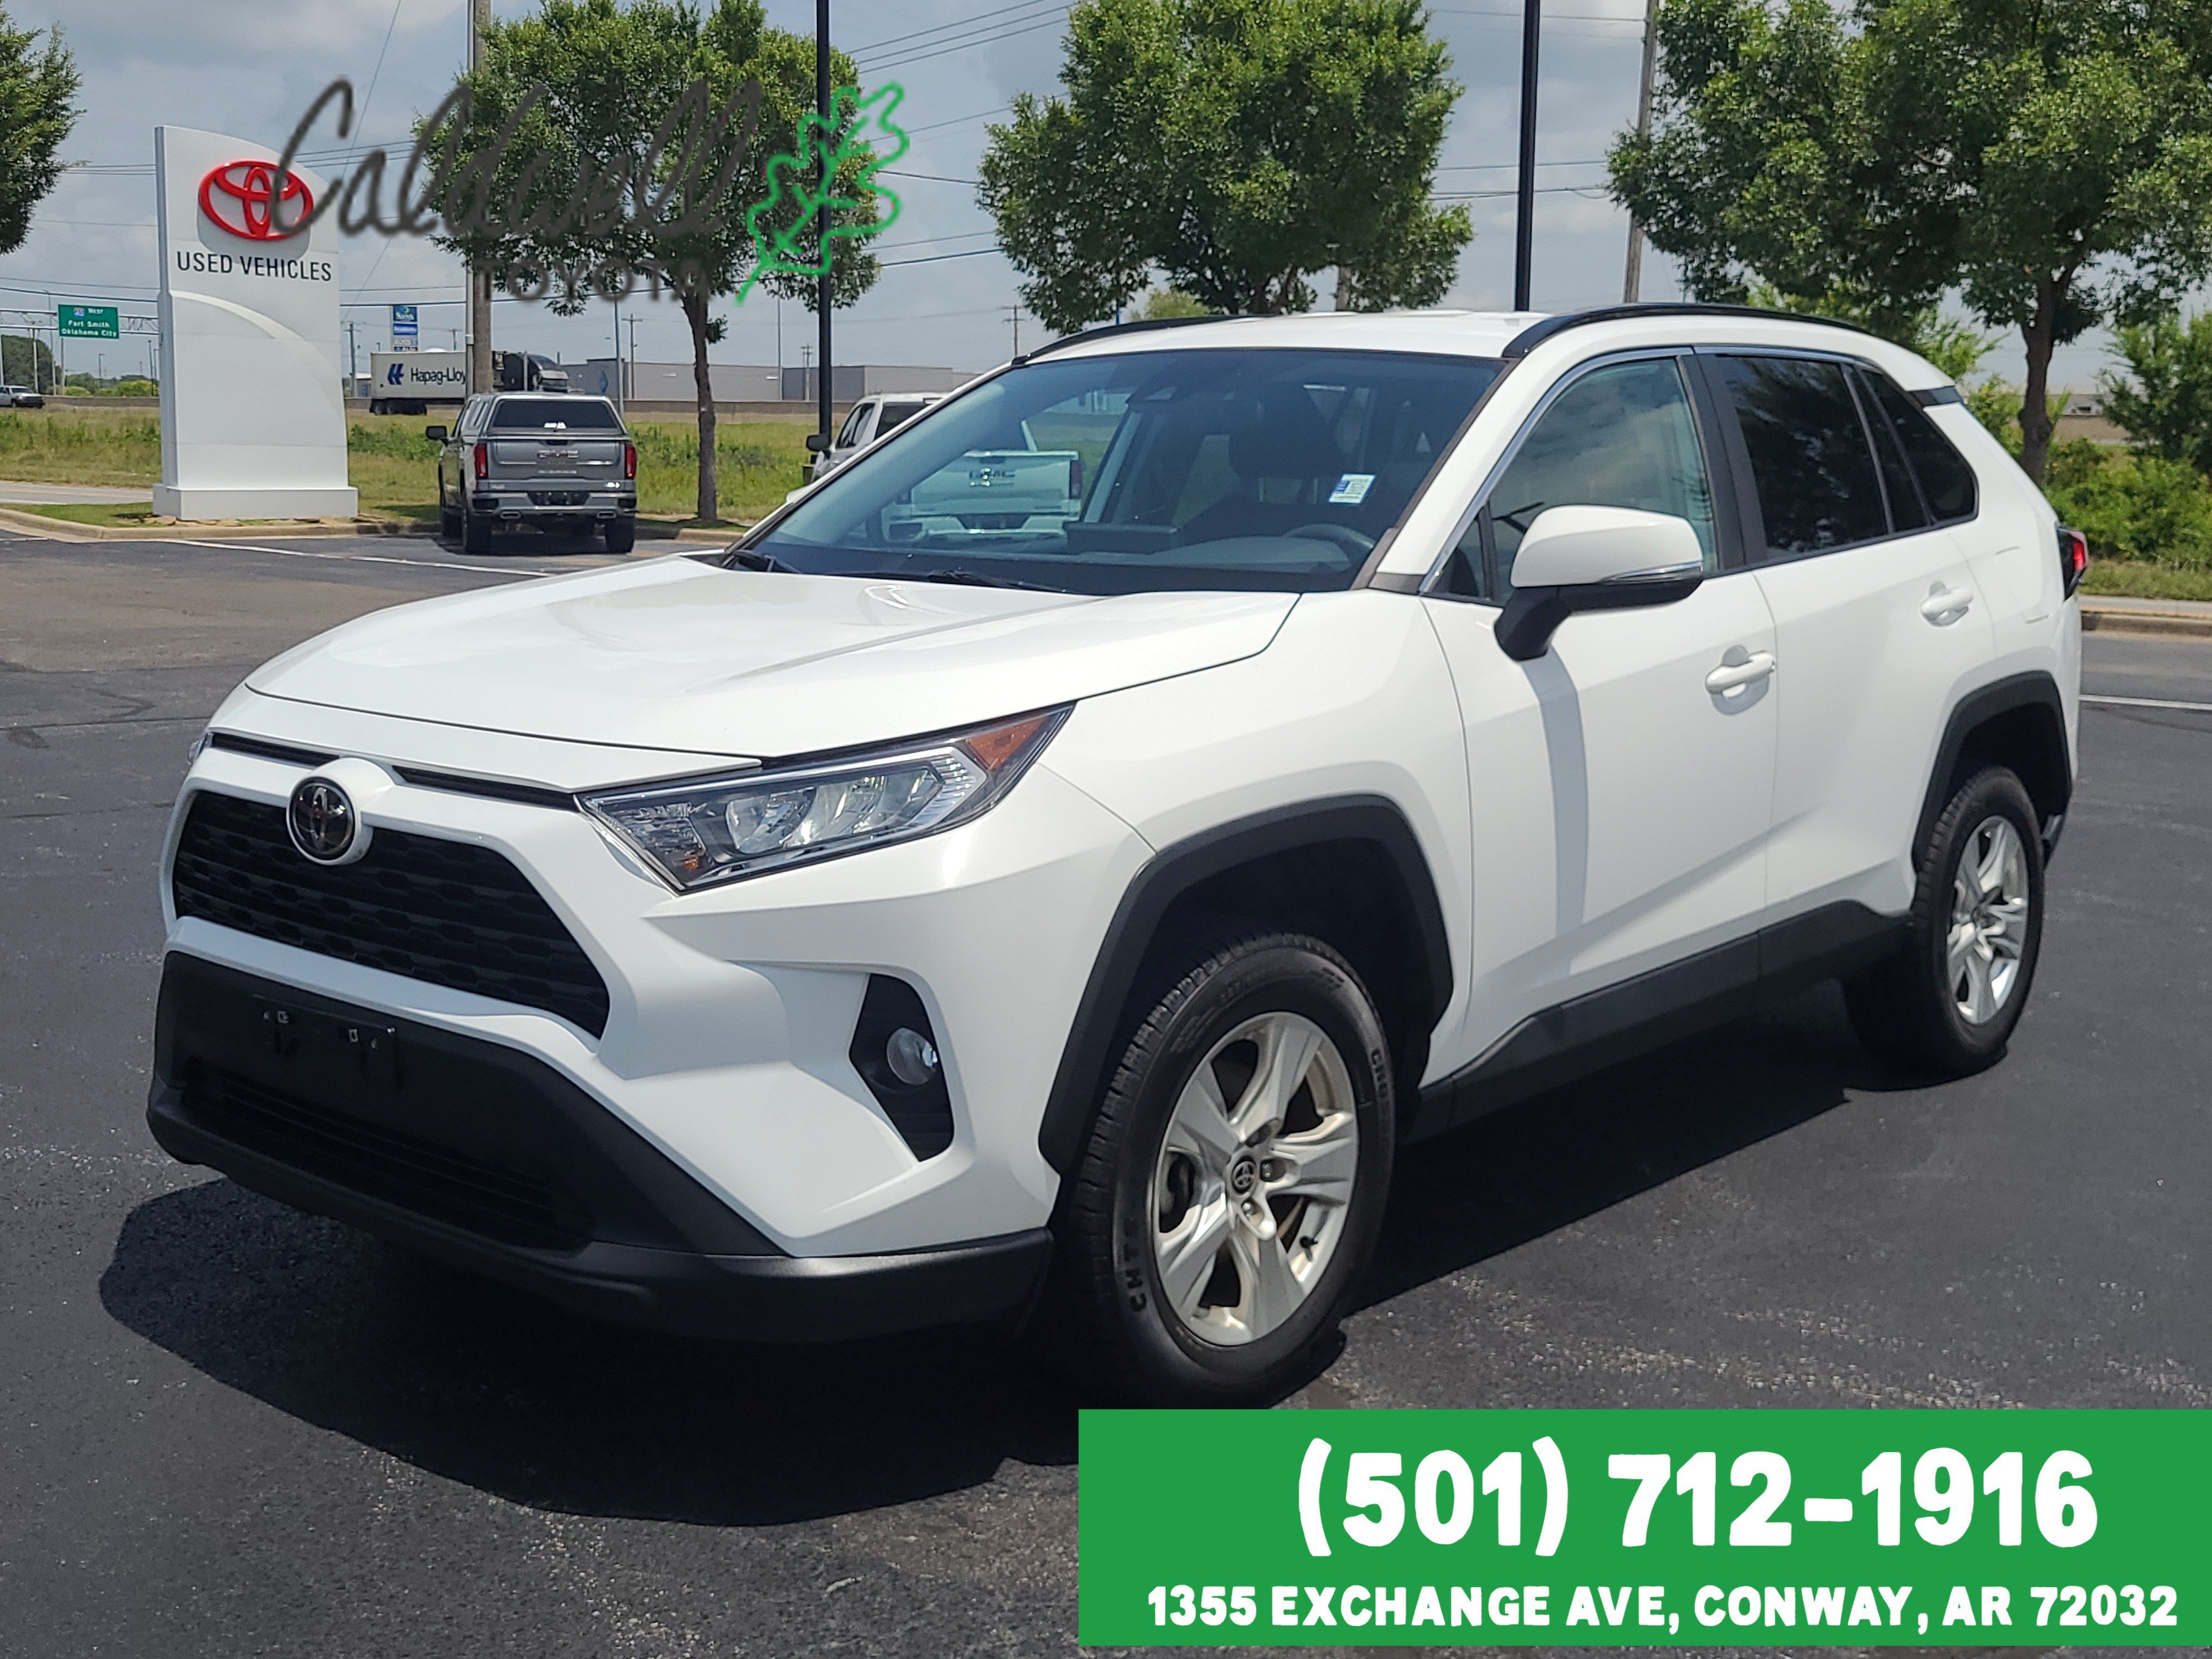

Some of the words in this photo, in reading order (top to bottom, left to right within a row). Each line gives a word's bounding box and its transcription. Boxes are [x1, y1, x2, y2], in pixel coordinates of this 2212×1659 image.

[177, 251, 233, 273] USED
[240, 256, 331, 281] VEHICLES
[411, 366, 466, 385] Hapag-Lloy
